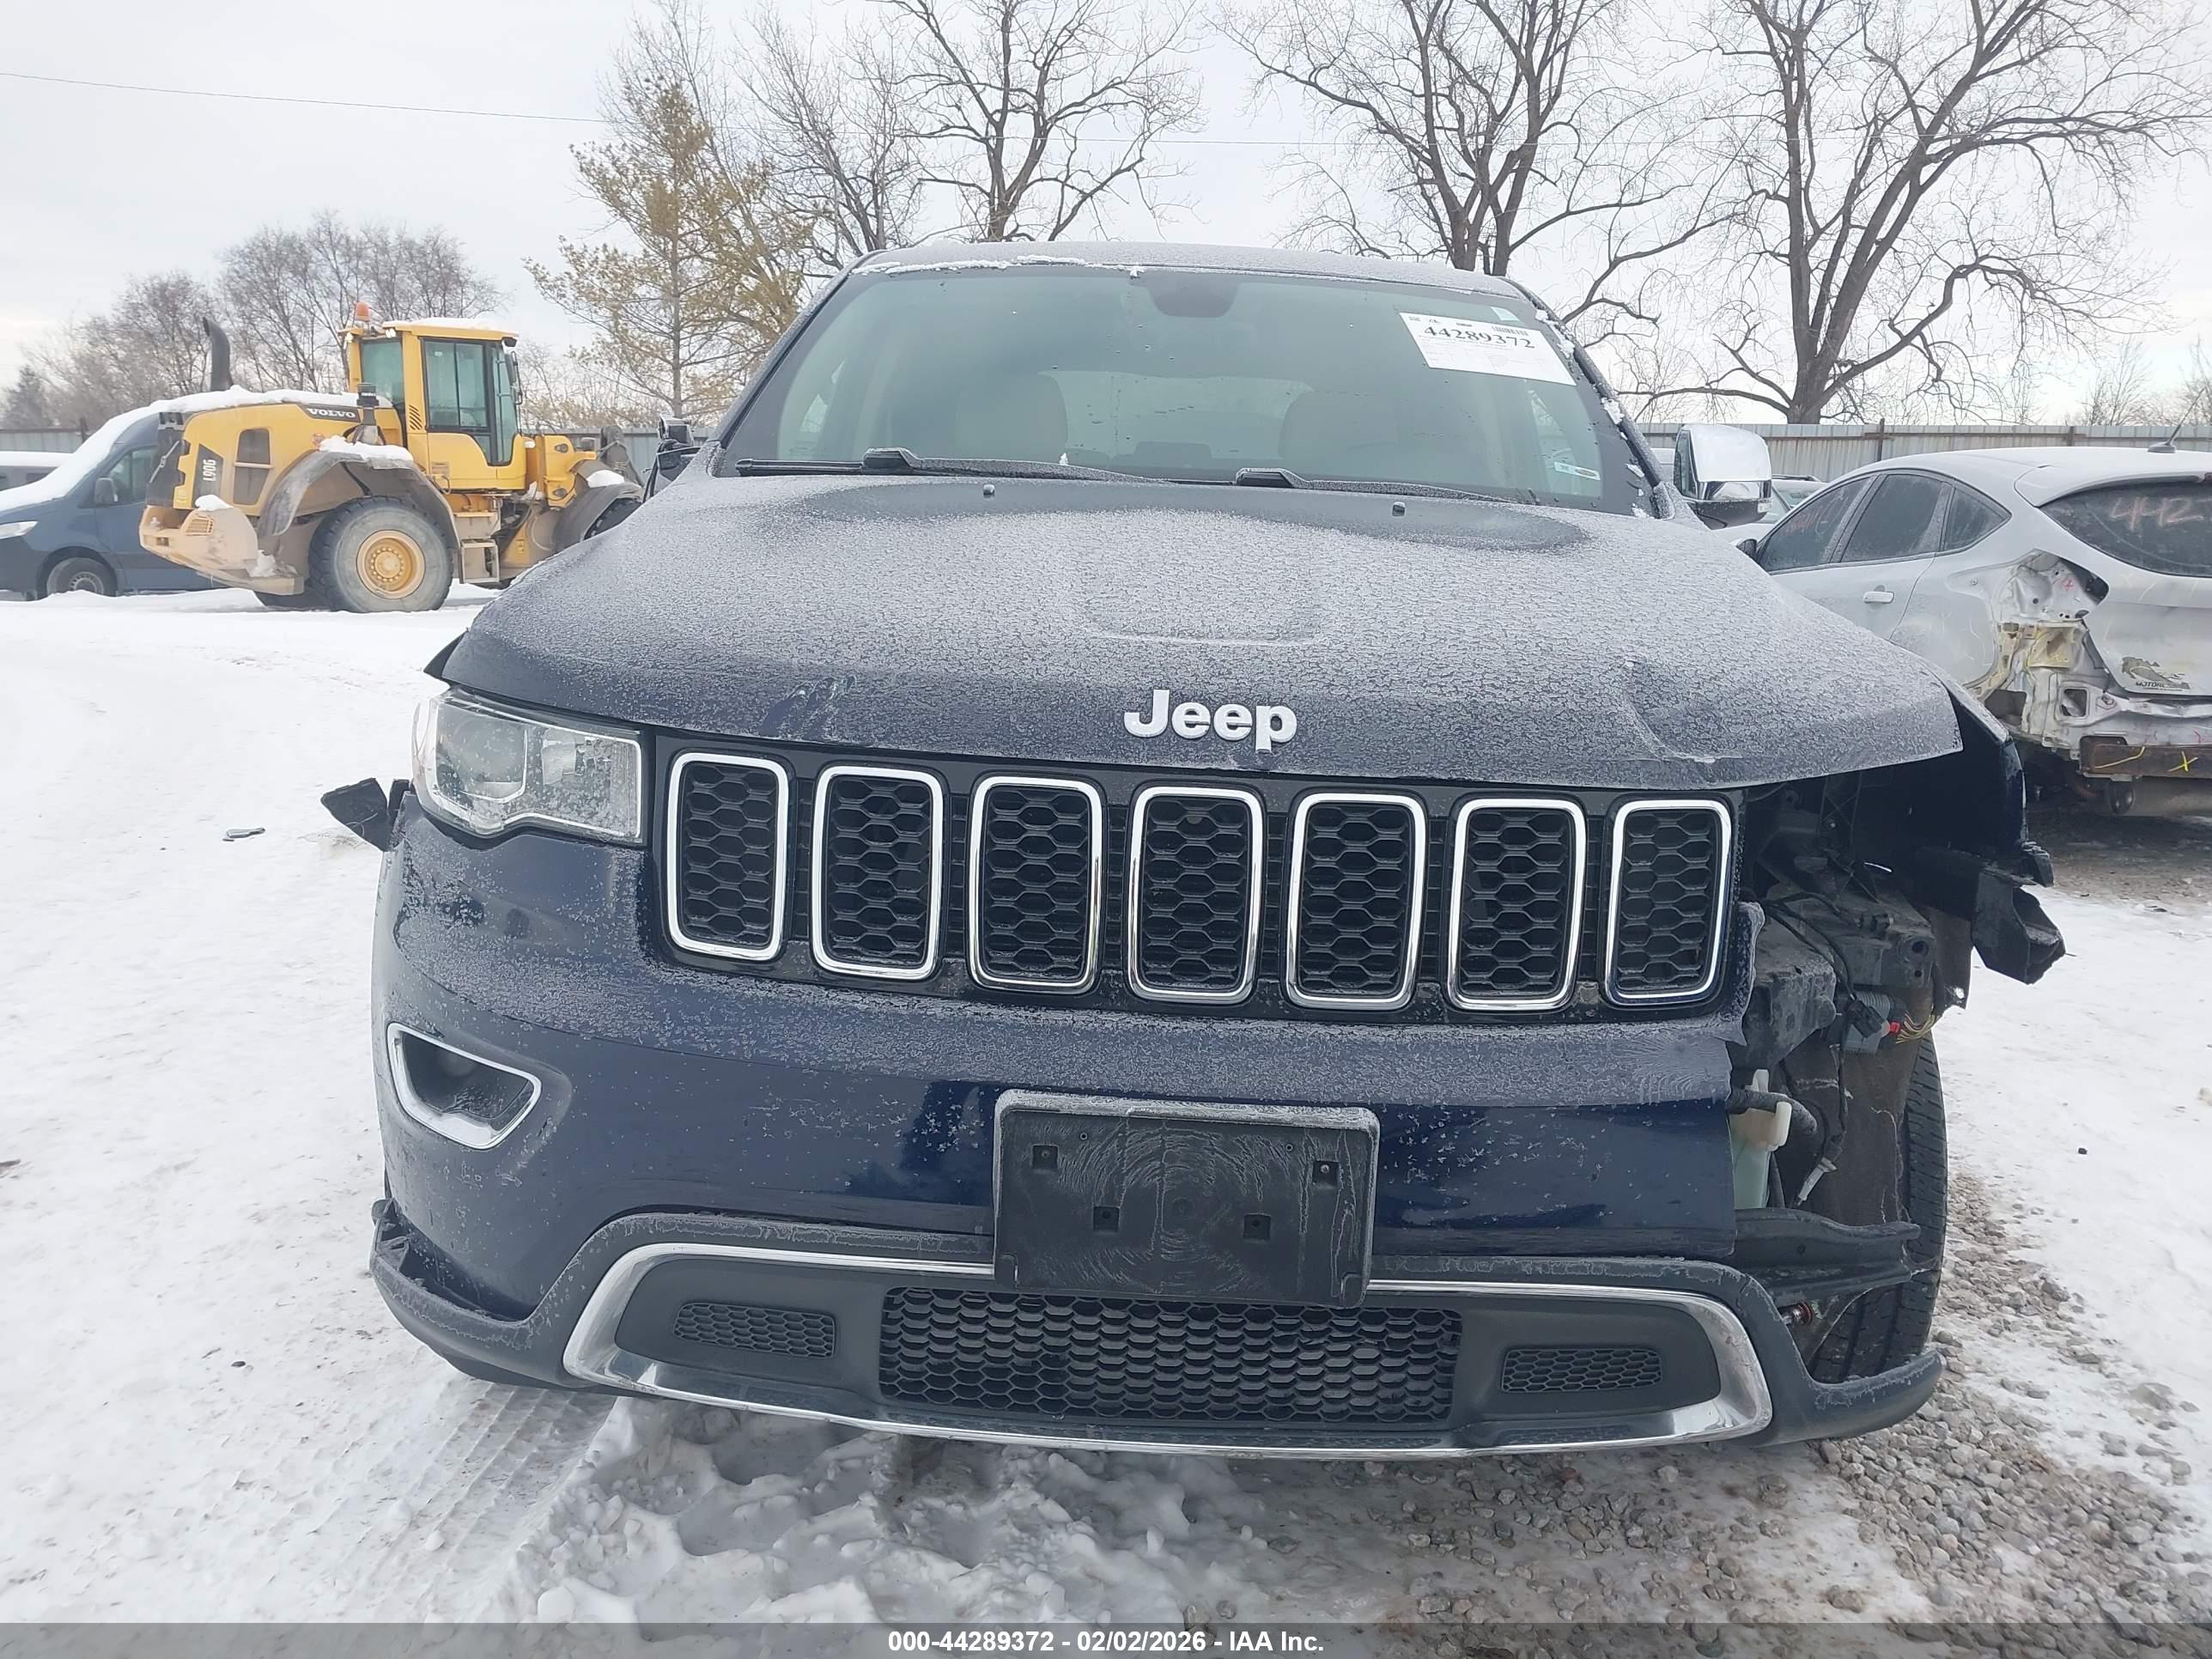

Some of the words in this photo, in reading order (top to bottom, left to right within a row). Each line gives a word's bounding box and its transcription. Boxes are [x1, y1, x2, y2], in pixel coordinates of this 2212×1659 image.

[1423, 325, 1535, 349] 44289372
[307, 408, 356, 418] VOLVO
[203, 459, 216, 482] L90G
[1123, 689, 1297, 754] Jeep
